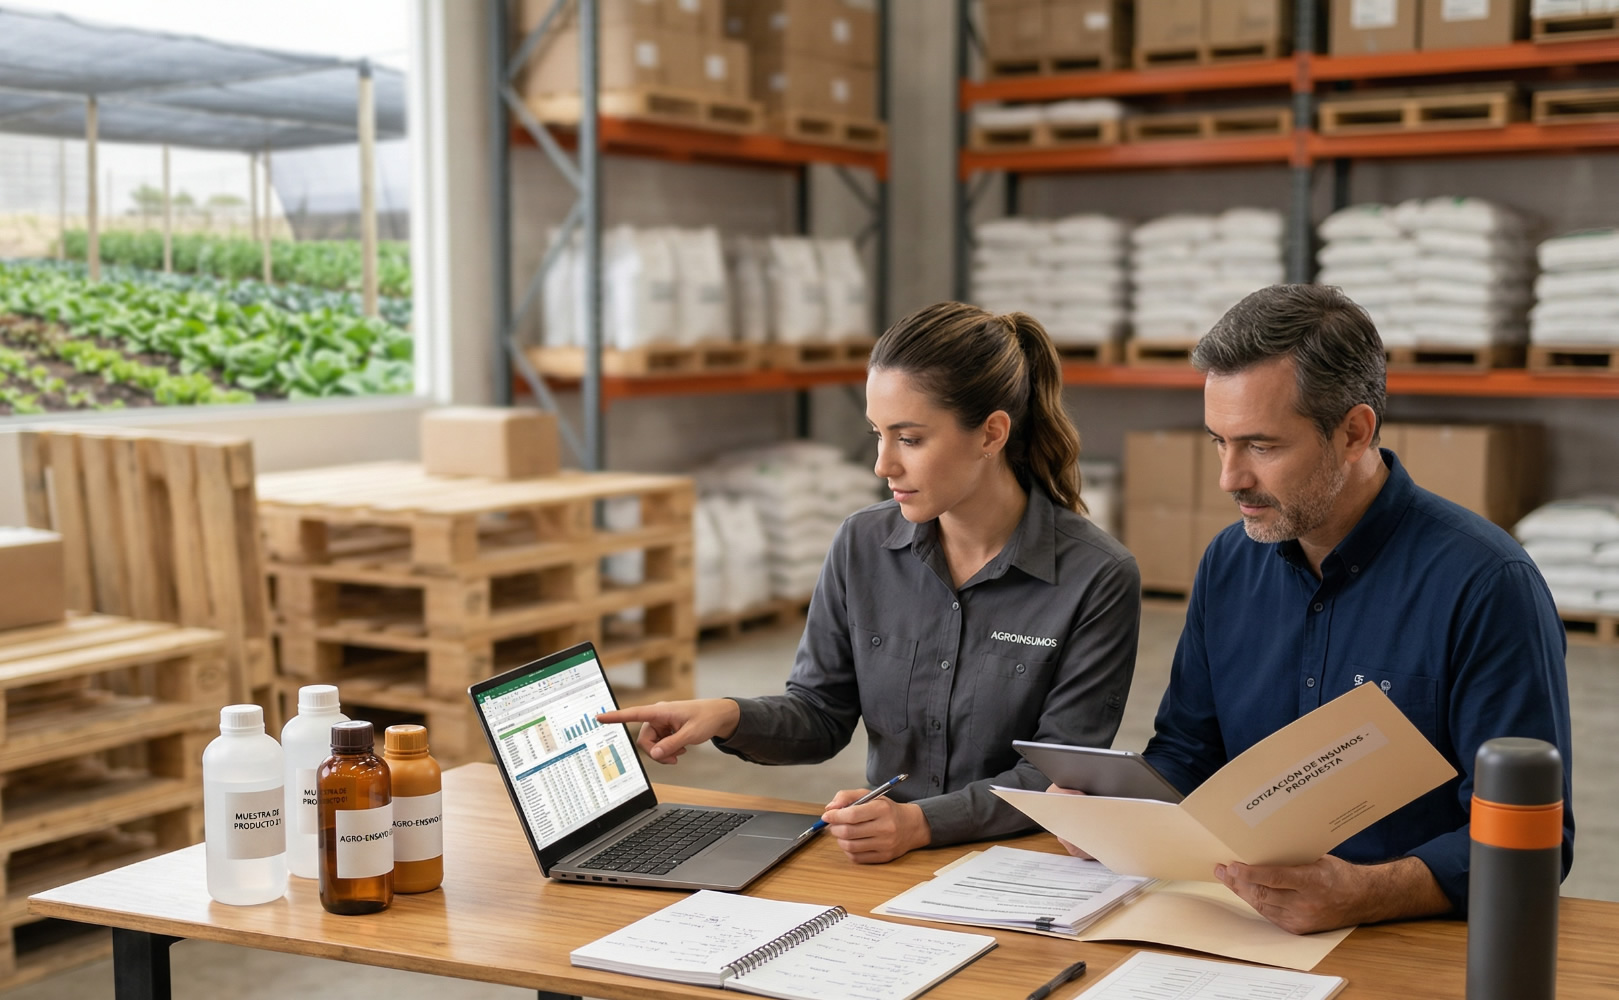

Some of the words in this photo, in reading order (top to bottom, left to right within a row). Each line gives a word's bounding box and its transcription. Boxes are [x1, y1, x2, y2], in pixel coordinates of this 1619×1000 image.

[990, 630, 1057, 647] AGROINSUMOS
[1246, 770, 1303, 811] COTIZACIÓN
[1302, 760, 1318, 773] DE
[1317, 734, 1364, 764] INSUMOS
[1285, 757, 1344, 794] PROPUESTA
[235, 810, 271, 820] MUESTRA
[233, 819, 275, 830] PRODUCTO
[339, 830, 389, 843] AGRO-ENSAYO
